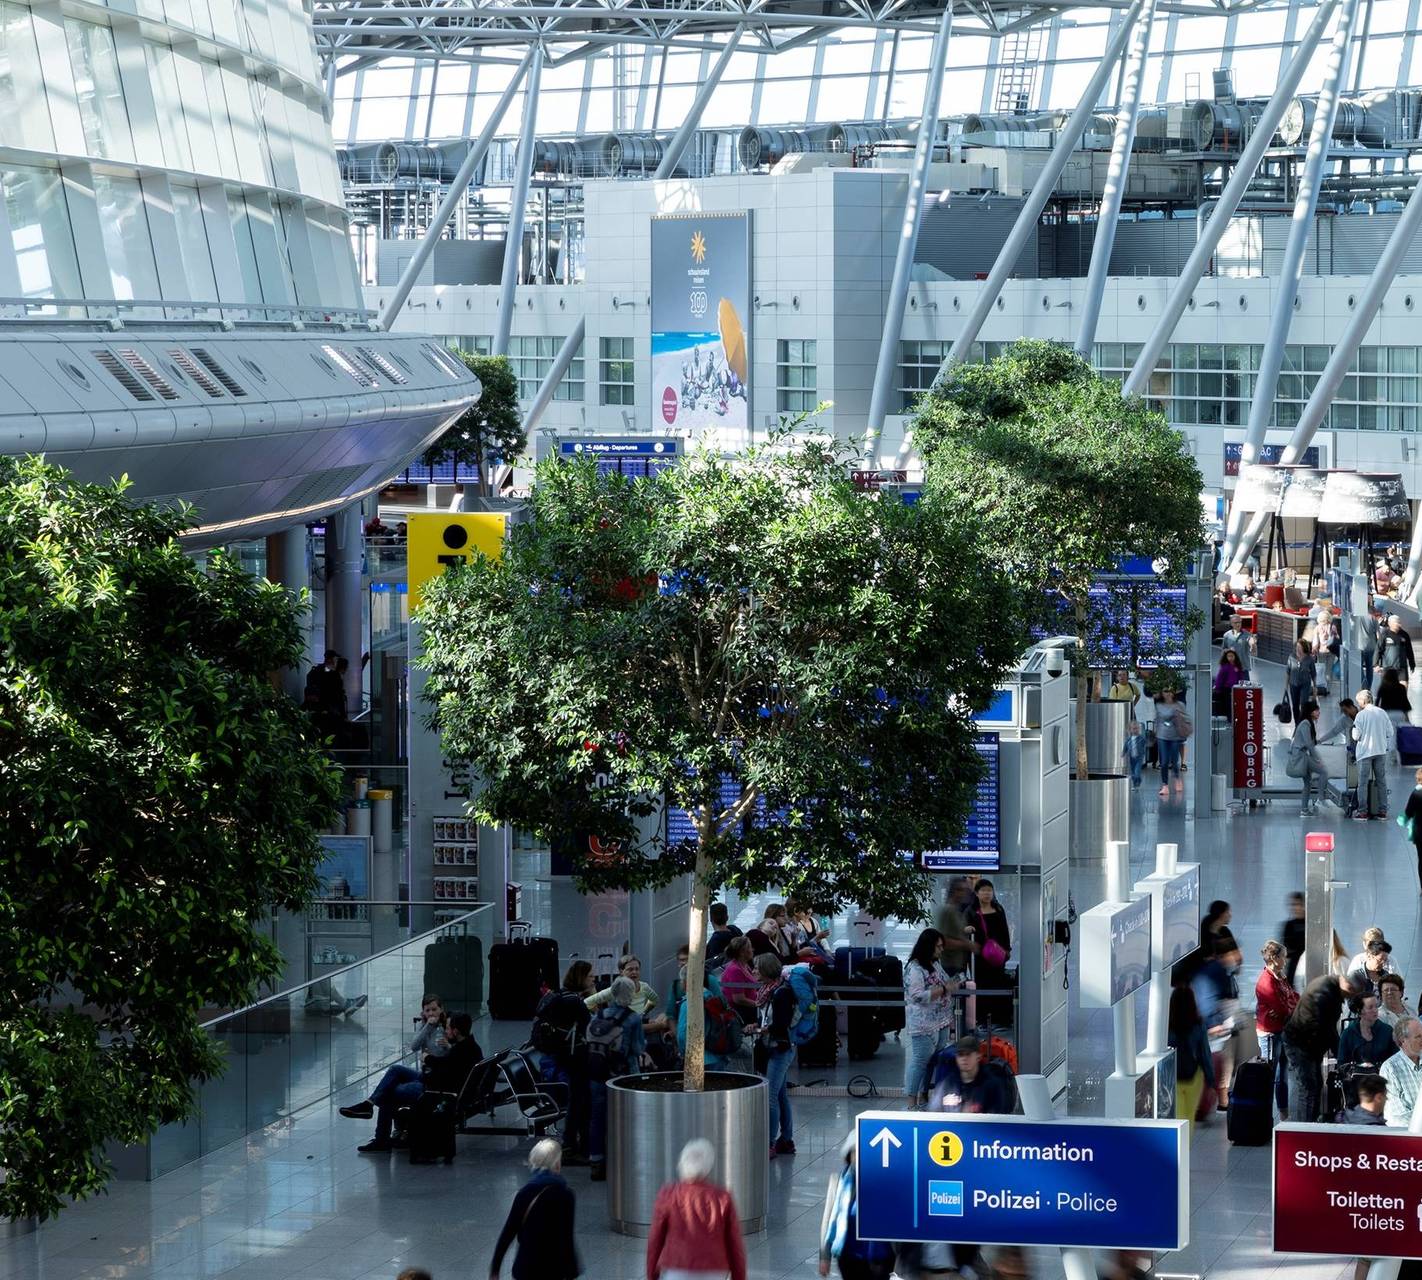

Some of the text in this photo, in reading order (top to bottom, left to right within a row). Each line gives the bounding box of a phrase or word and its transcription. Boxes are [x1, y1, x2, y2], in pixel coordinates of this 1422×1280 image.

[1246, 757, 1257, 788] BAG
[972, 1139, 1094, 1162] Information
[1294, 1150, 1353, 1173] Shops
[1356, 1153, 1371, 1169] &
[931, 1191, 961, 1206] Polizei
[972, 1190, 1041, 1210] Polizei
[1057, 1192, 1118, 1213] Police
[1326, 1190, 1405, 1210] Toiletten
[1348, 1213, 1405, 1232] Toilets
